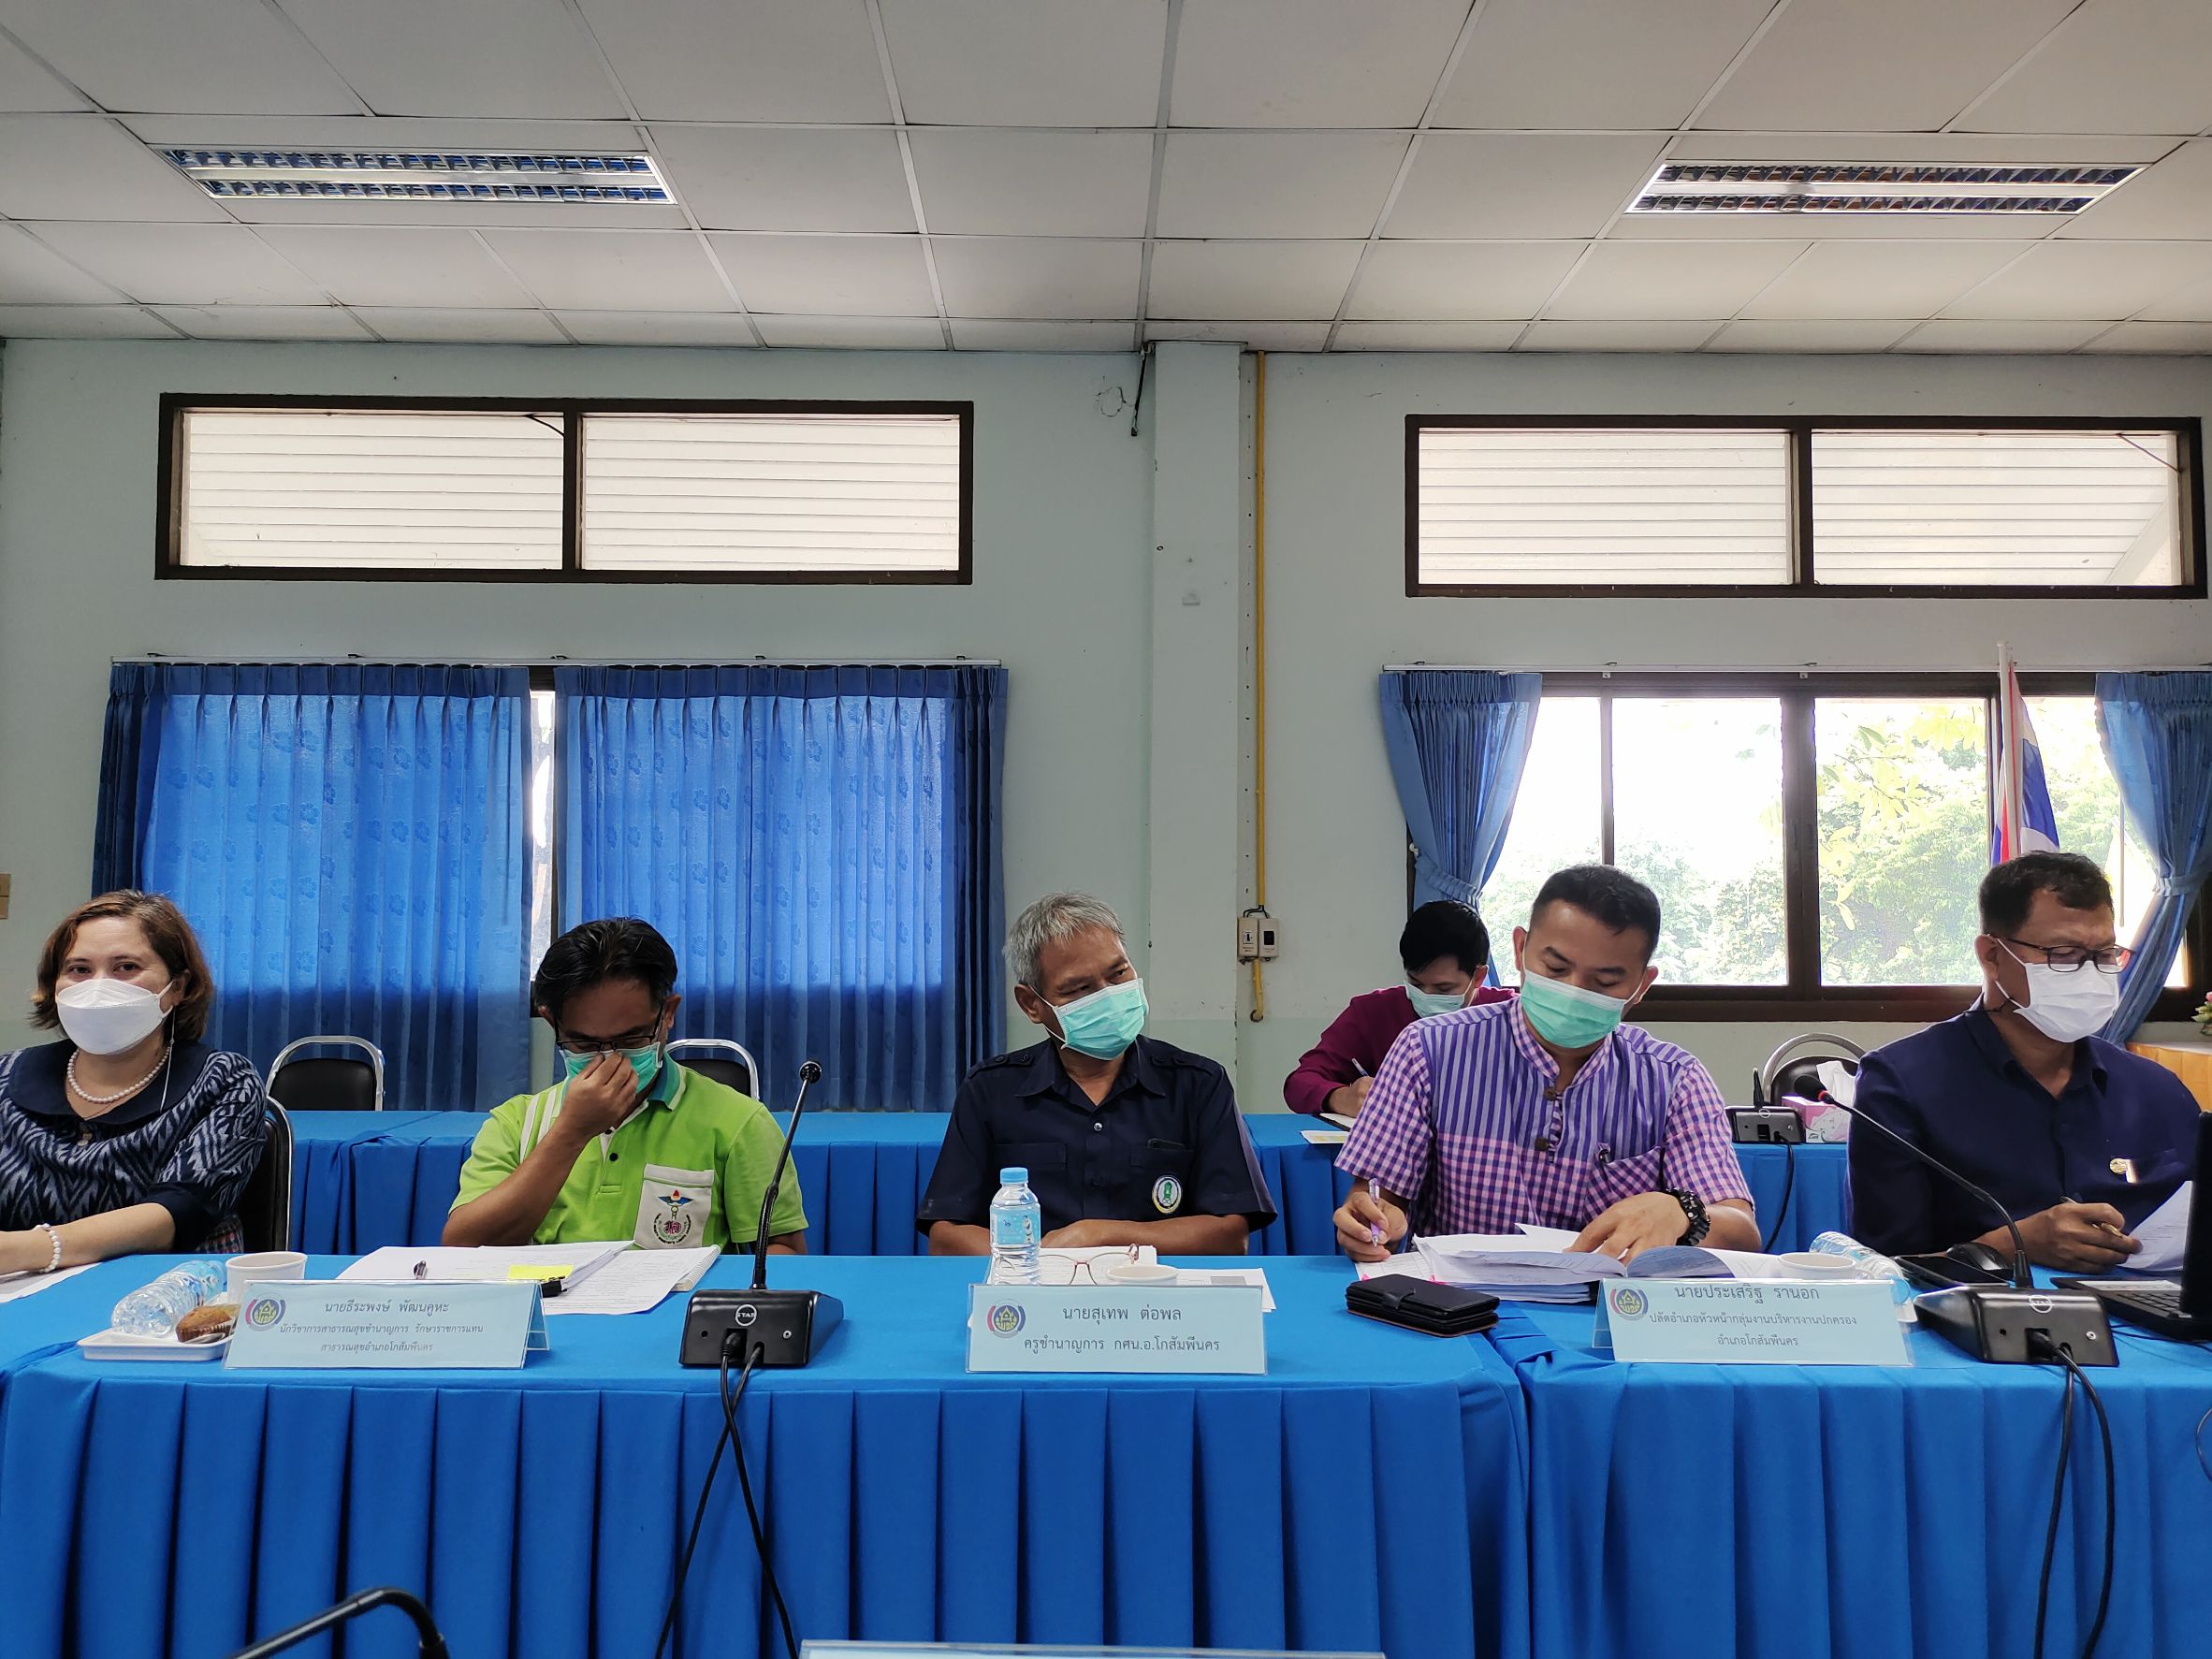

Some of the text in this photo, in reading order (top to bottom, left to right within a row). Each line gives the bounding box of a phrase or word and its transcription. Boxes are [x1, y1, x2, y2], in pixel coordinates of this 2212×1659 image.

[1674, 1283, 1820, 1303] นายประเสริฐ รานอก
[1063, 1303, 1182, 1326] นายสุเทพ ต่อพล
[1024, 1334, 1104, 1355] ครูชำนาญการ
